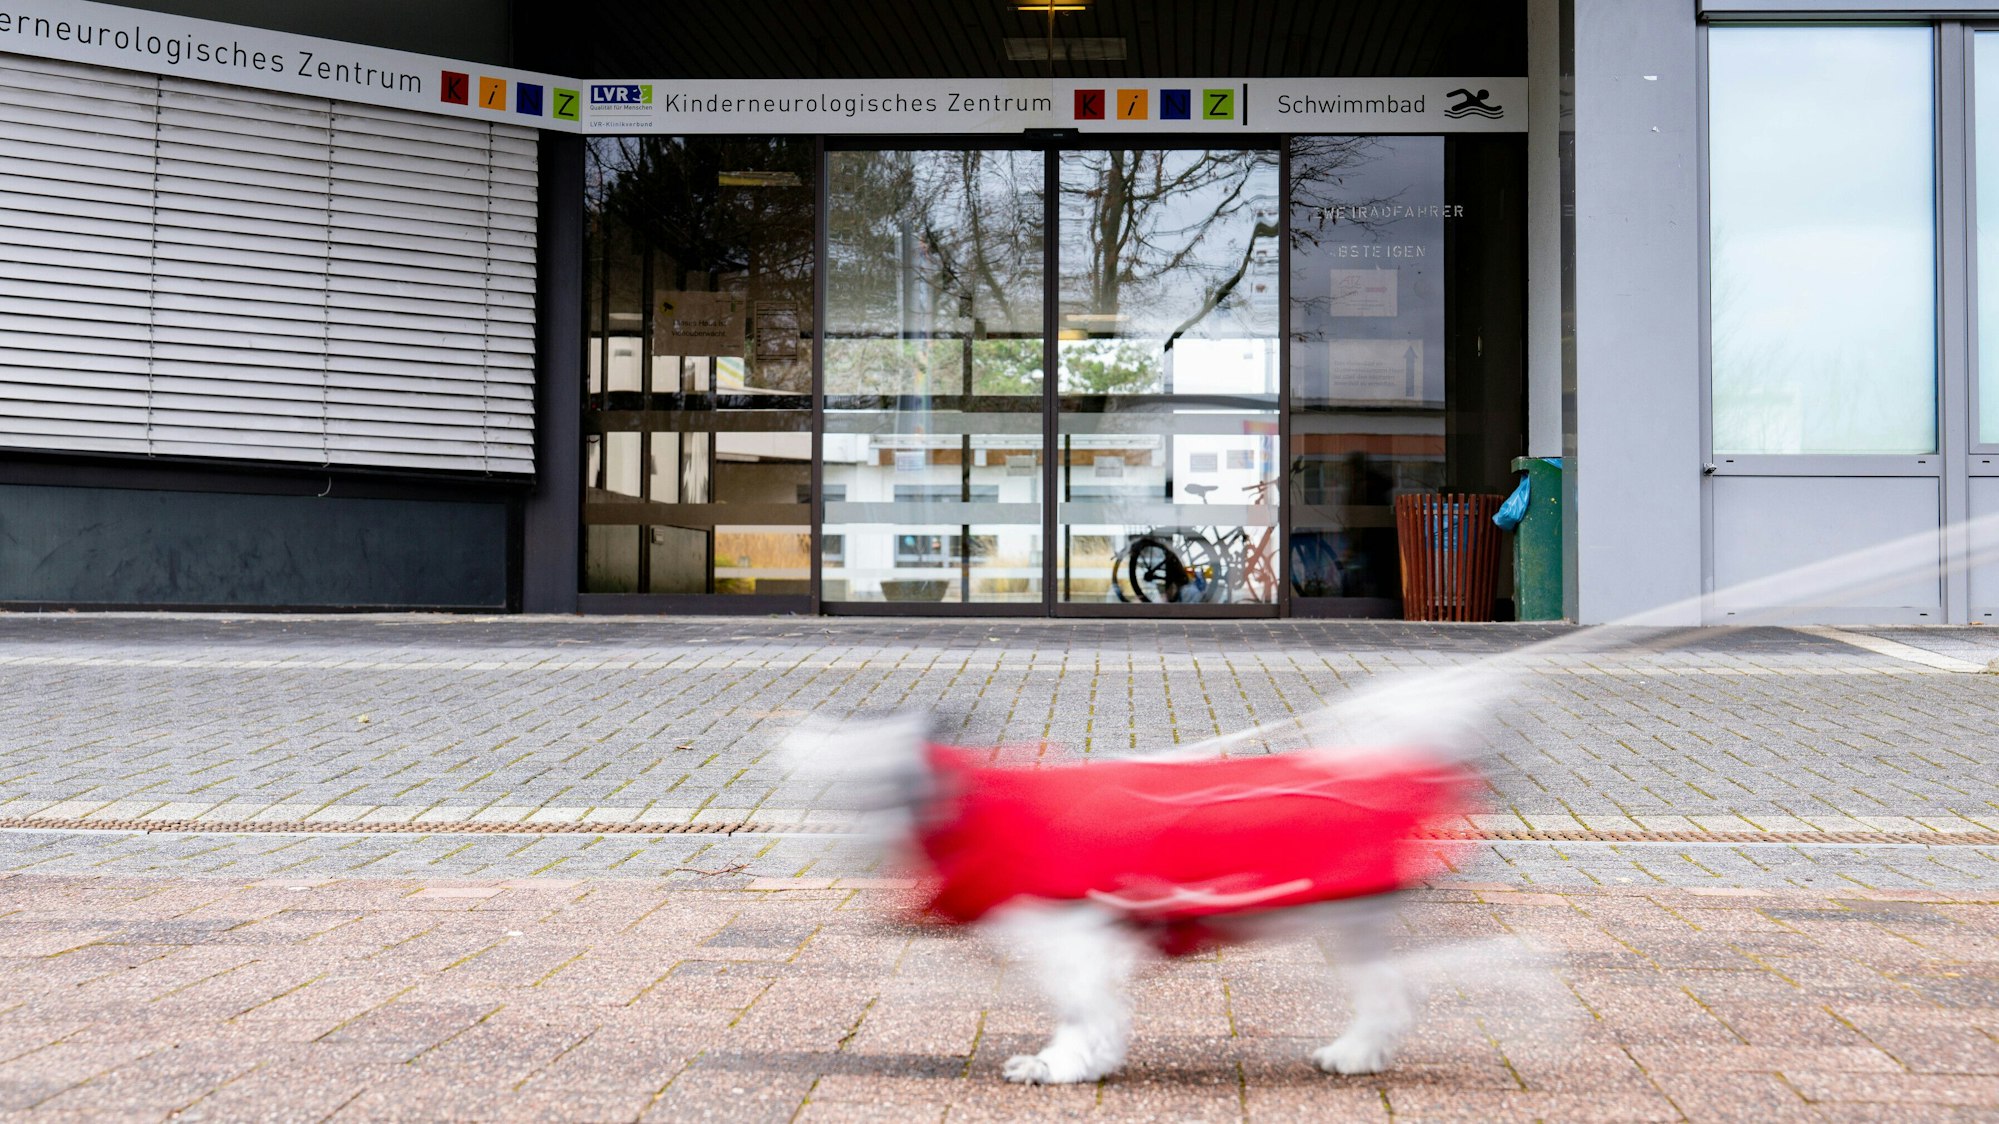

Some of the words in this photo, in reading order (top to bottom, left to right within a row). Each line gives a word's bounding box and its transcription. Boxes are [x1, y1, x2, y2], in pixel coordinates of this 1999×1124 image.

[0, 13, 285, 73] erneurologisches
[297, 51, 422, 94] Zentrum
[593, 87, 629, 102] LVR
[665, 93, 937, 117] Kinderneurologisches
[948, 93, 1051, 112] Zentrum
[1278, 94, 1425, 114] Schwimmbad
